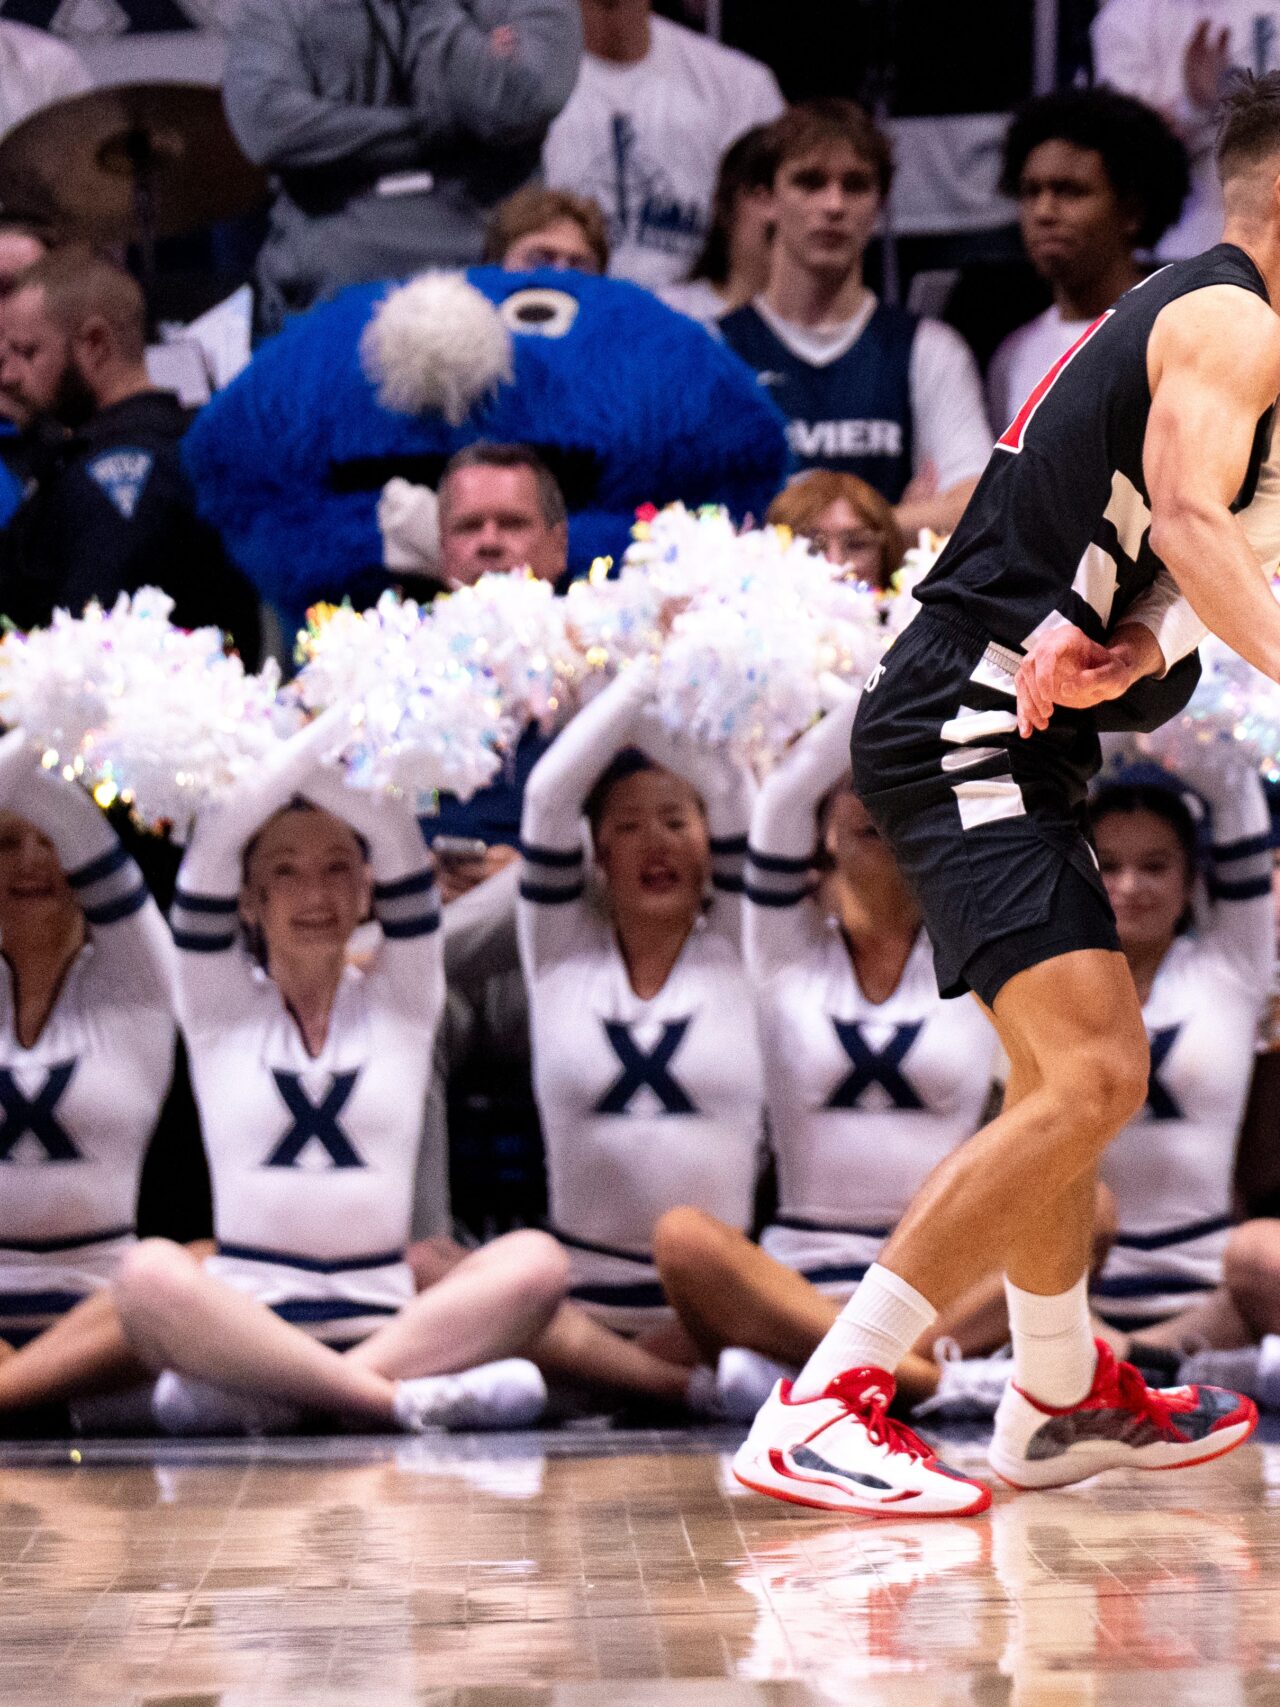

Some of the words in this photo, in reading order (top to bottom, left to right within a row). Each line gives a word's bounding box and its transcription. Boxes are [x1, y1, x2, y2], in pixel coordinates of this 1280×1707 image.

[593, 1014, 698, 1115] X
[825, 1017, 929, 1109] X
[264, 1066, 366, 1167] X
